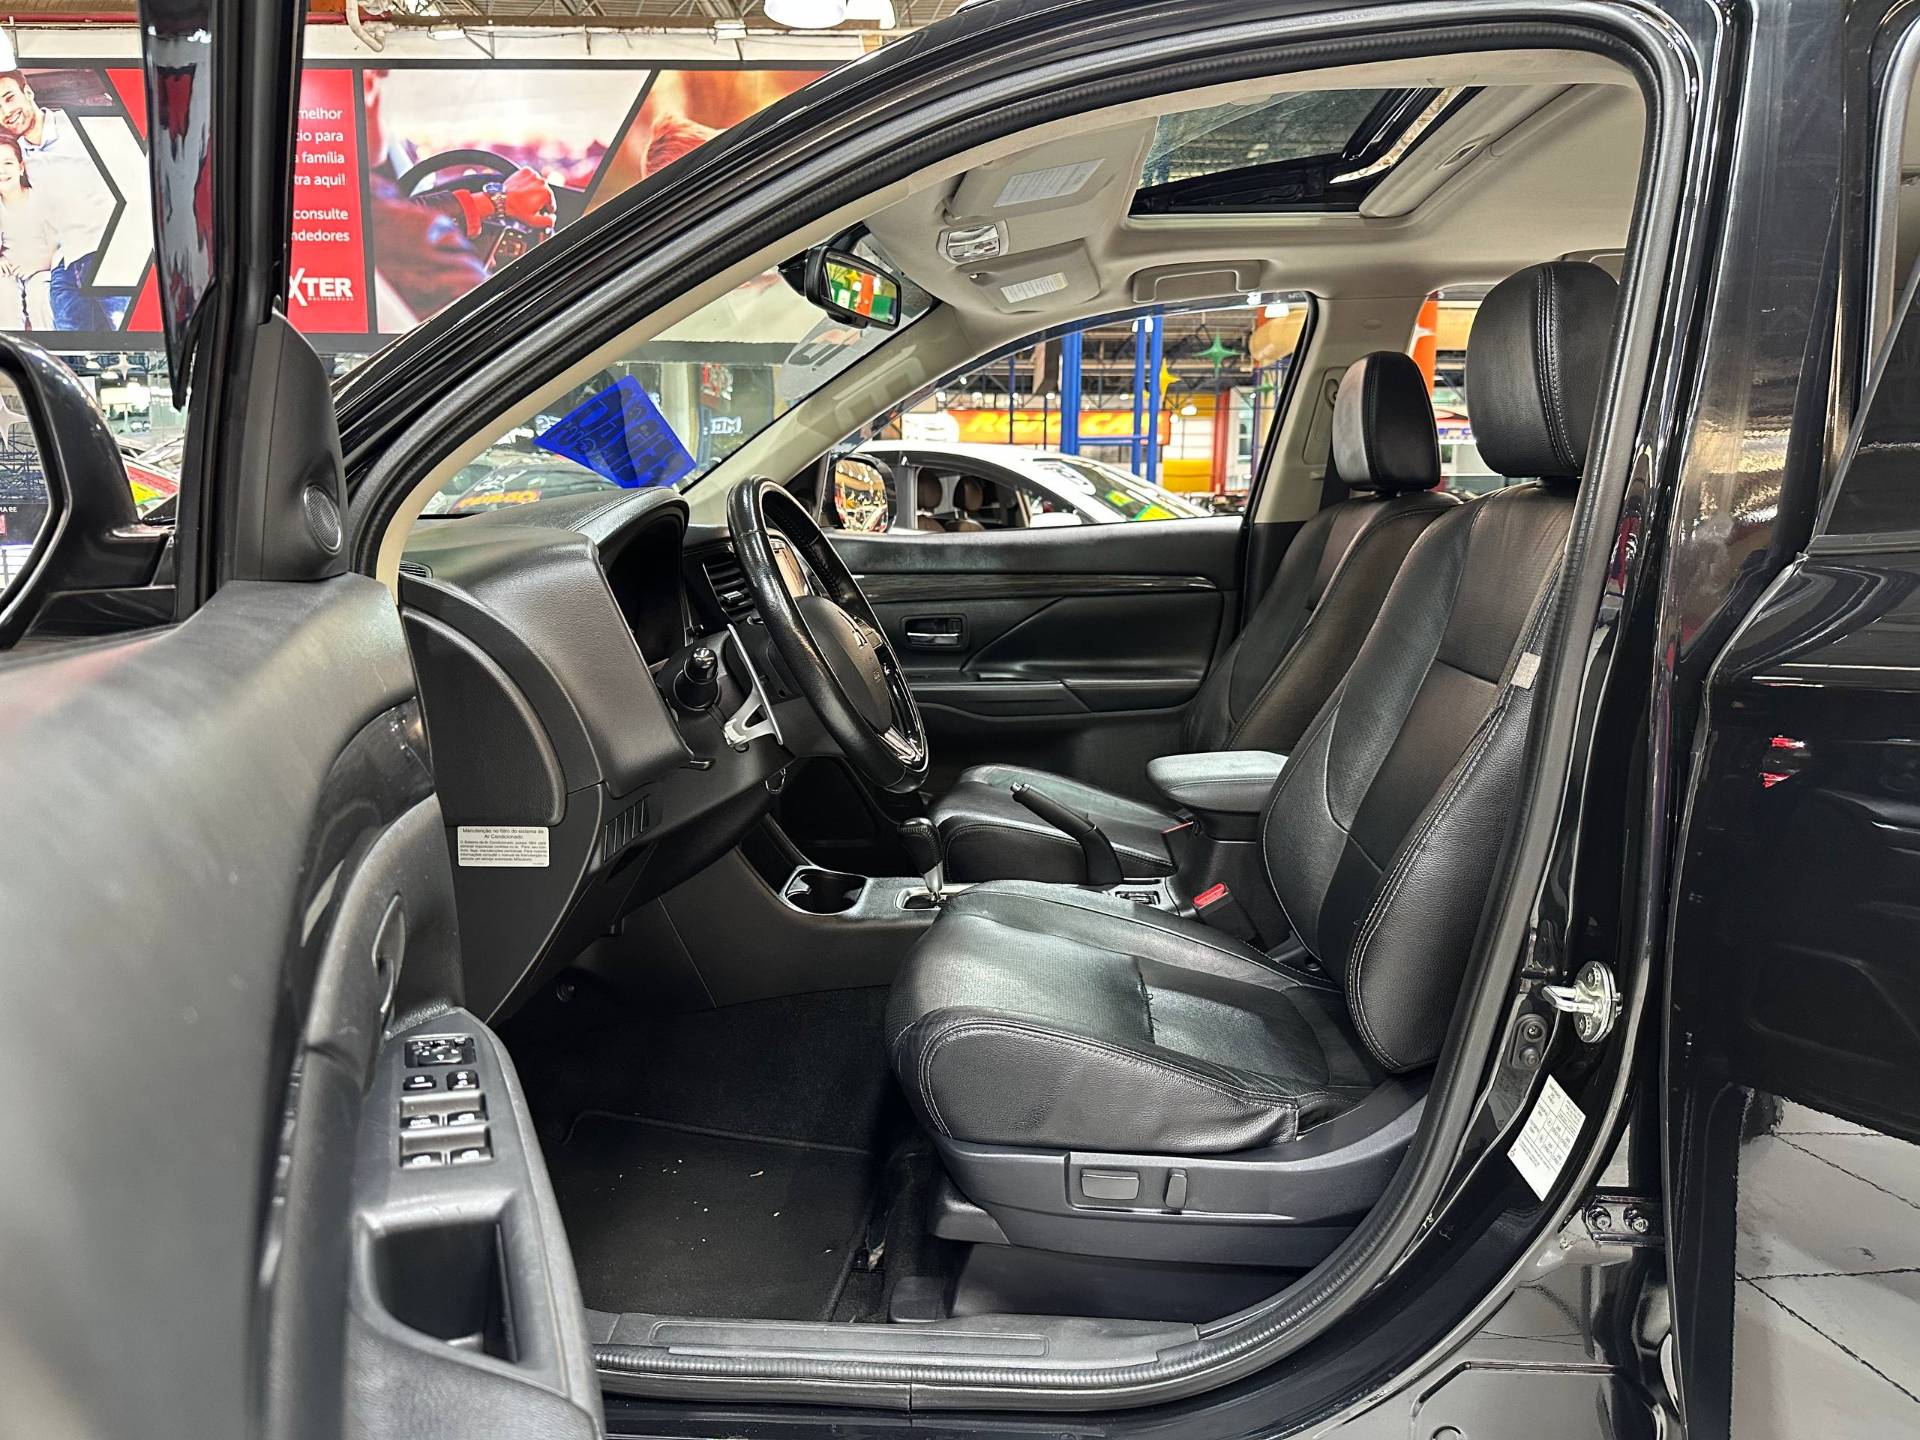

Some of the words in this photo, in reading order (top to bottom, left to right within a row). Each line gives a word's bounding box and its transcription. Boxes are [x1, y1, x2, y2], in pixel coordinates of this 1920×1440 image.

[315, 131, 344, 145] para
[302, 151, 345, 164] família
[314, 172, 346, 189] aqui!
[293, 208, 349, 220] consulte
